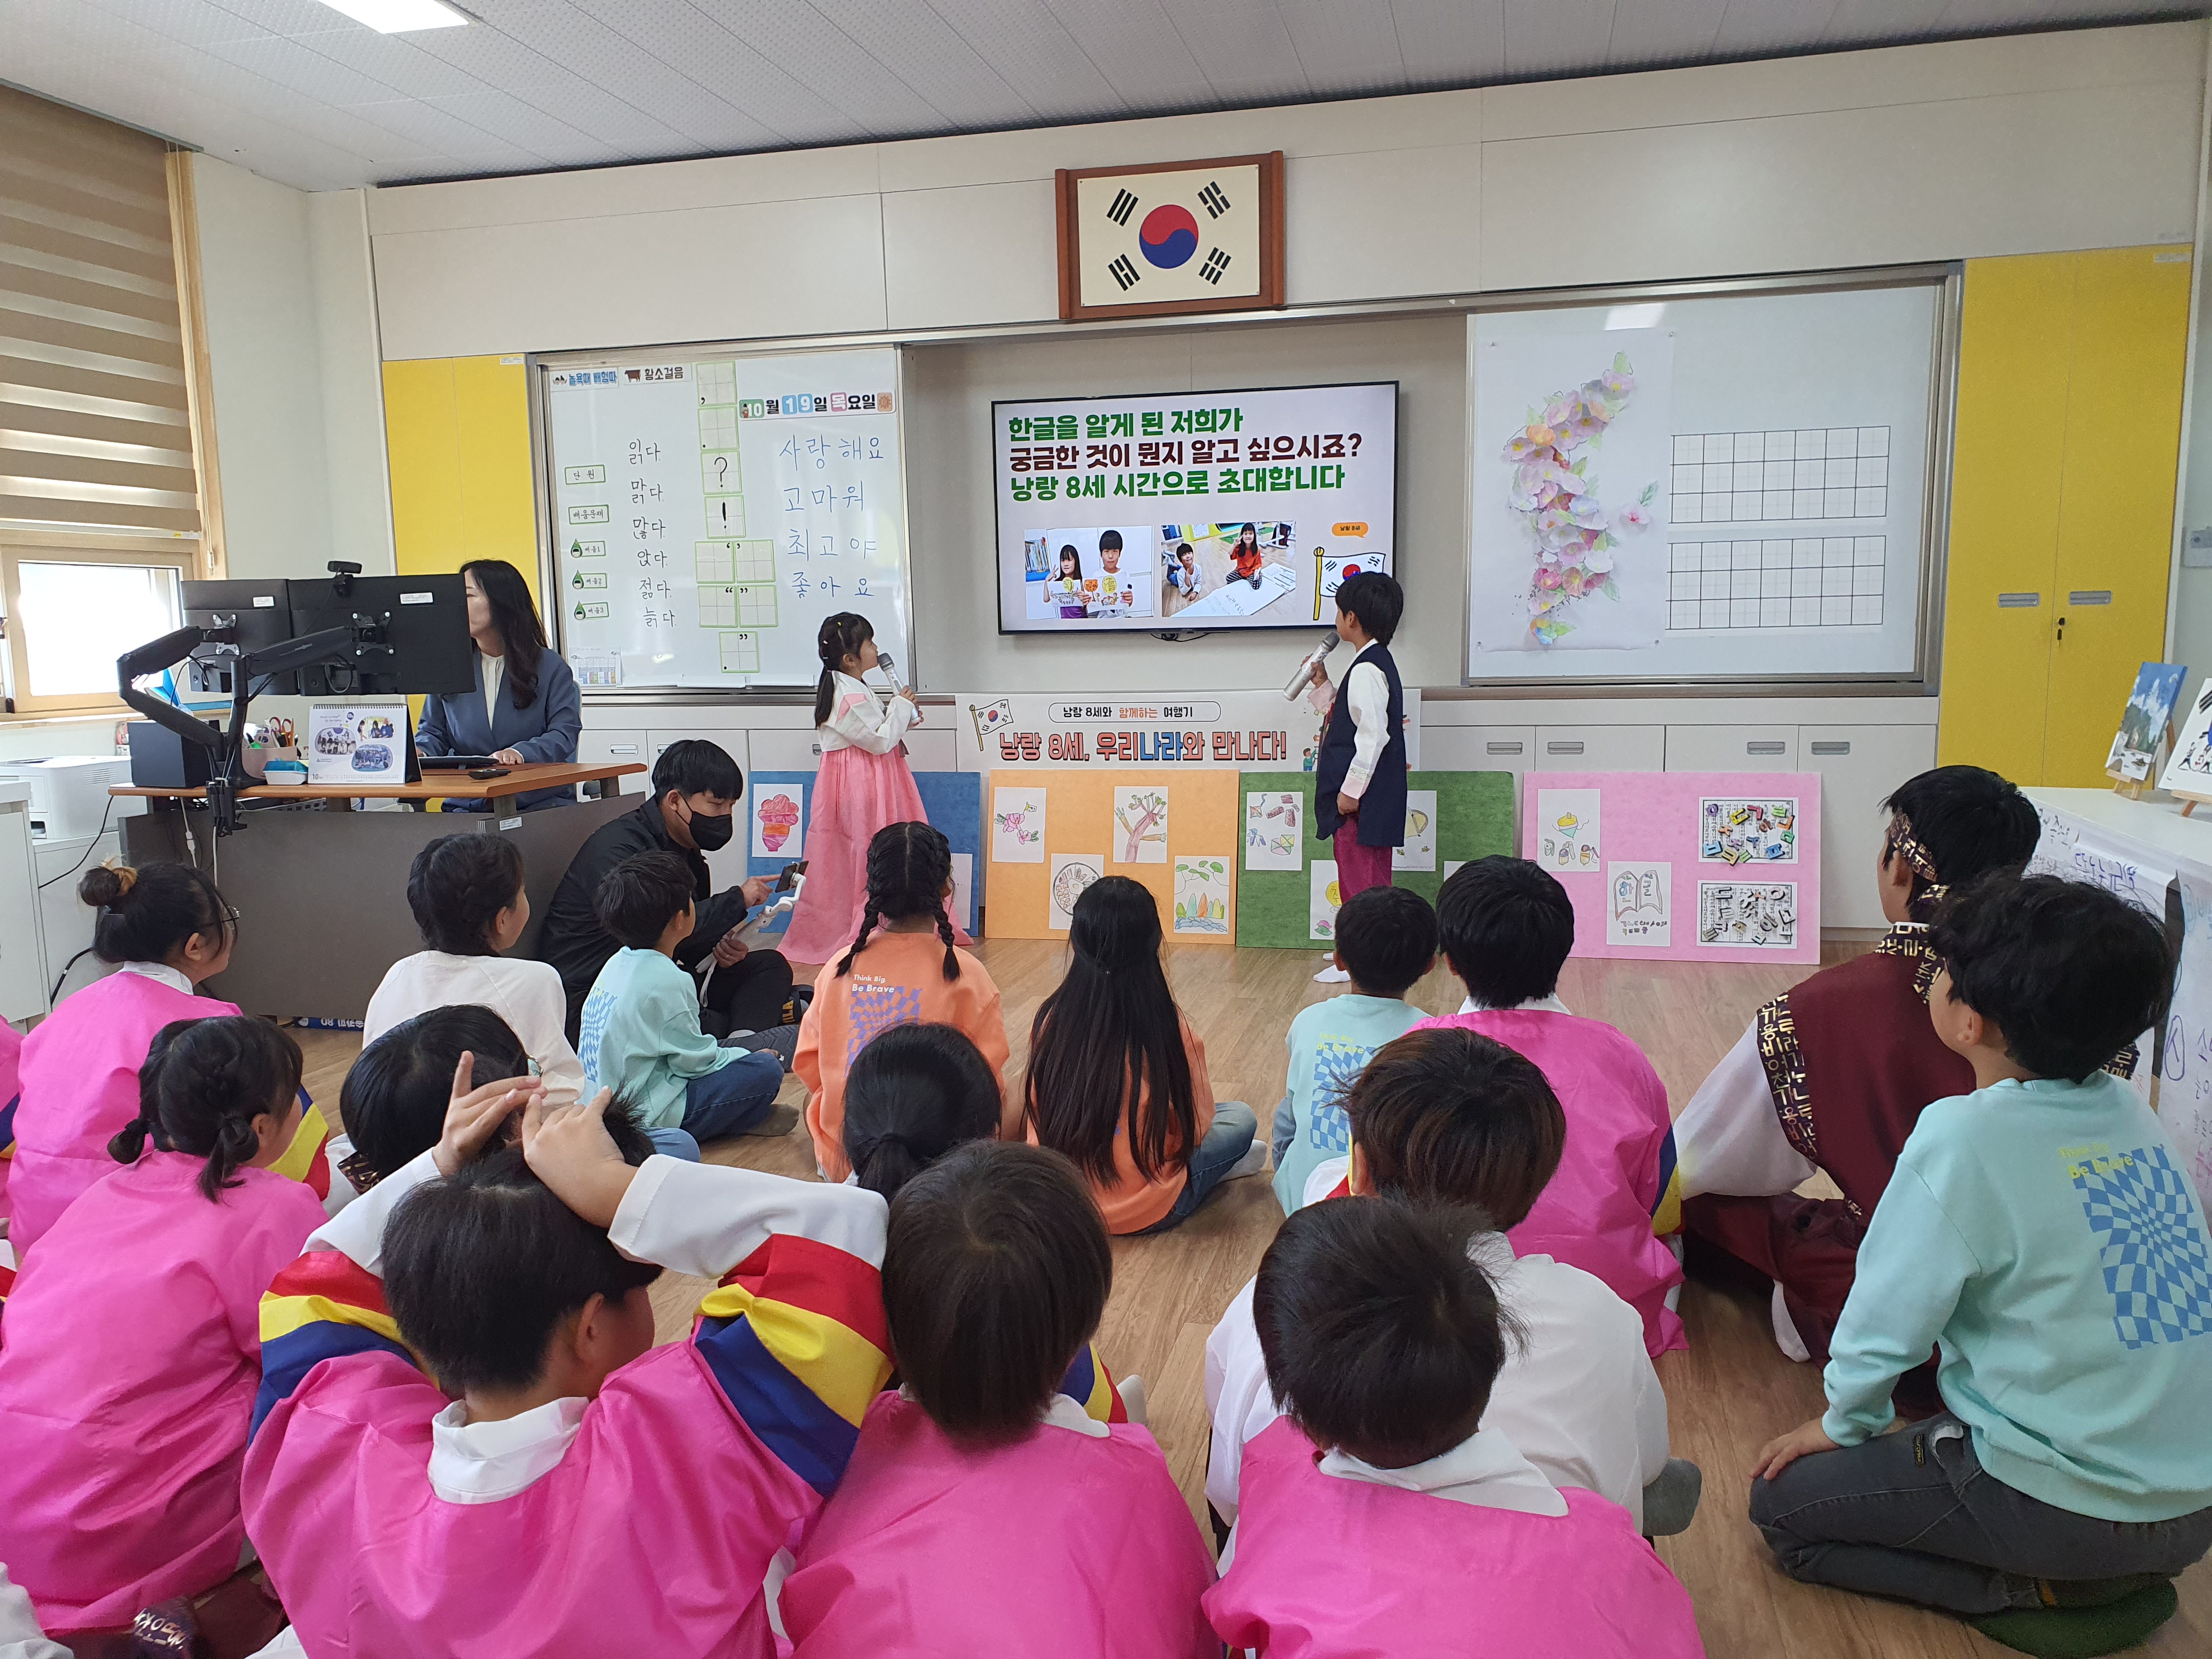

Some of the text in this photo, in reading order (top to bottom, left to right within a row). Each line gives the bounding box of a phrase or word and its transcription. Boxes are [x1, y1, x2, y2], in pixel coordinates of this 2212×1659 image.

[644, 366, 684, 381] 황소걸음
[785, 396, 828, 413] 19일
[832, 394, 876, 410] 목요일
[1008, 408, 1244, 442] 한글을 알게 된 저희가
[779, 435, 884, 471] 사랑해요
[1009, 433, 1363, 472] 궁금한 것이 뭔지 알고 싶으시죠?
[783, 480, 864, 512] 고마워
[1011, 465, 1345, 501] 낭랑 8세 시간으로 초대합니다
[573, 509, 603, 520] 배움문제
[787, 529, 877, 562] 최고야
[791, 572, 874, 599] 좋아요
[1063, 706, 1193, 719] 낭랑 8세와 함께하는 여행기
[999, 731, 1287, 761] 낭랑 8세, 우리나라와 만나다!
[852, 984, 895, 993] Be Brave
